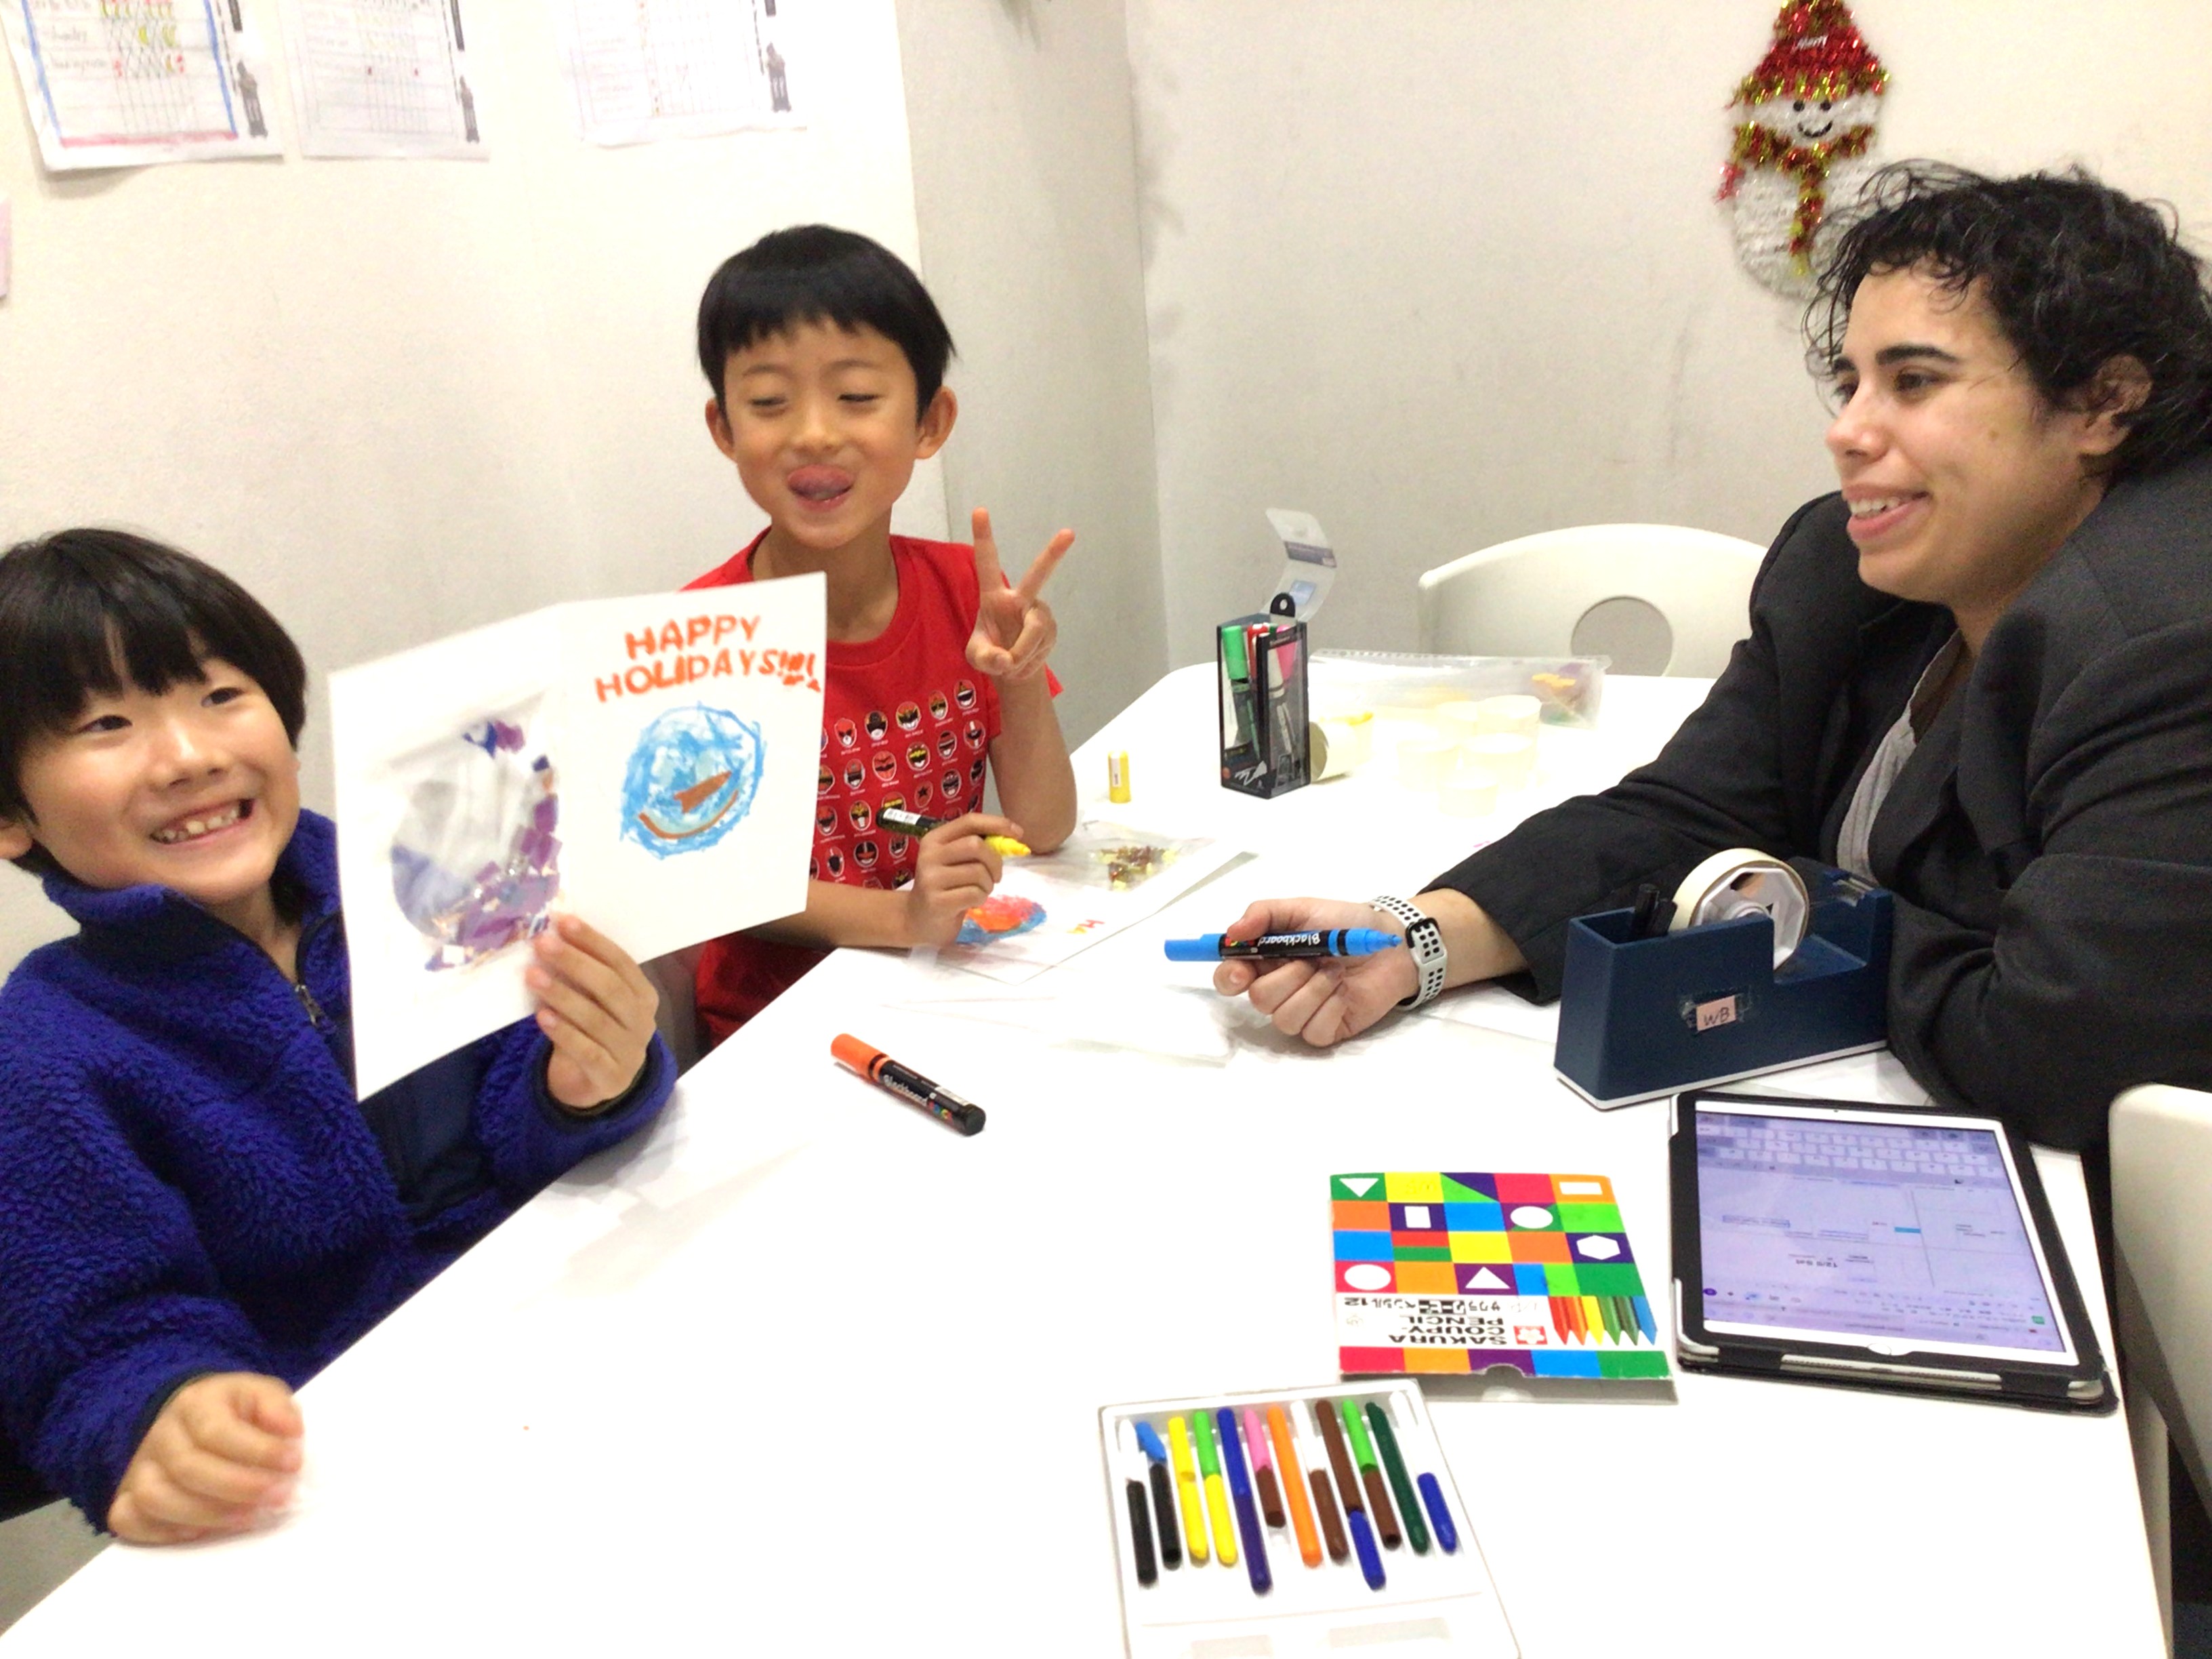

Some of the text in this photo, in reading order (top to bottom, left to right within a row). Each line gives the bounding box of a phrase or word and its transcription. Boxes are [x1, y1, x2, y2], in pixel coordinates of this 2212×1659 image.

[624, 614, 760, 660] HAPPY
[1257, 932, 1321, 947] Blackboard
[1703, 1006, 1730, 1026] WB
[1400, 1314, 1504, 1326] PENCIL
[1388, 1334, 1508, 1345] SAKURA
